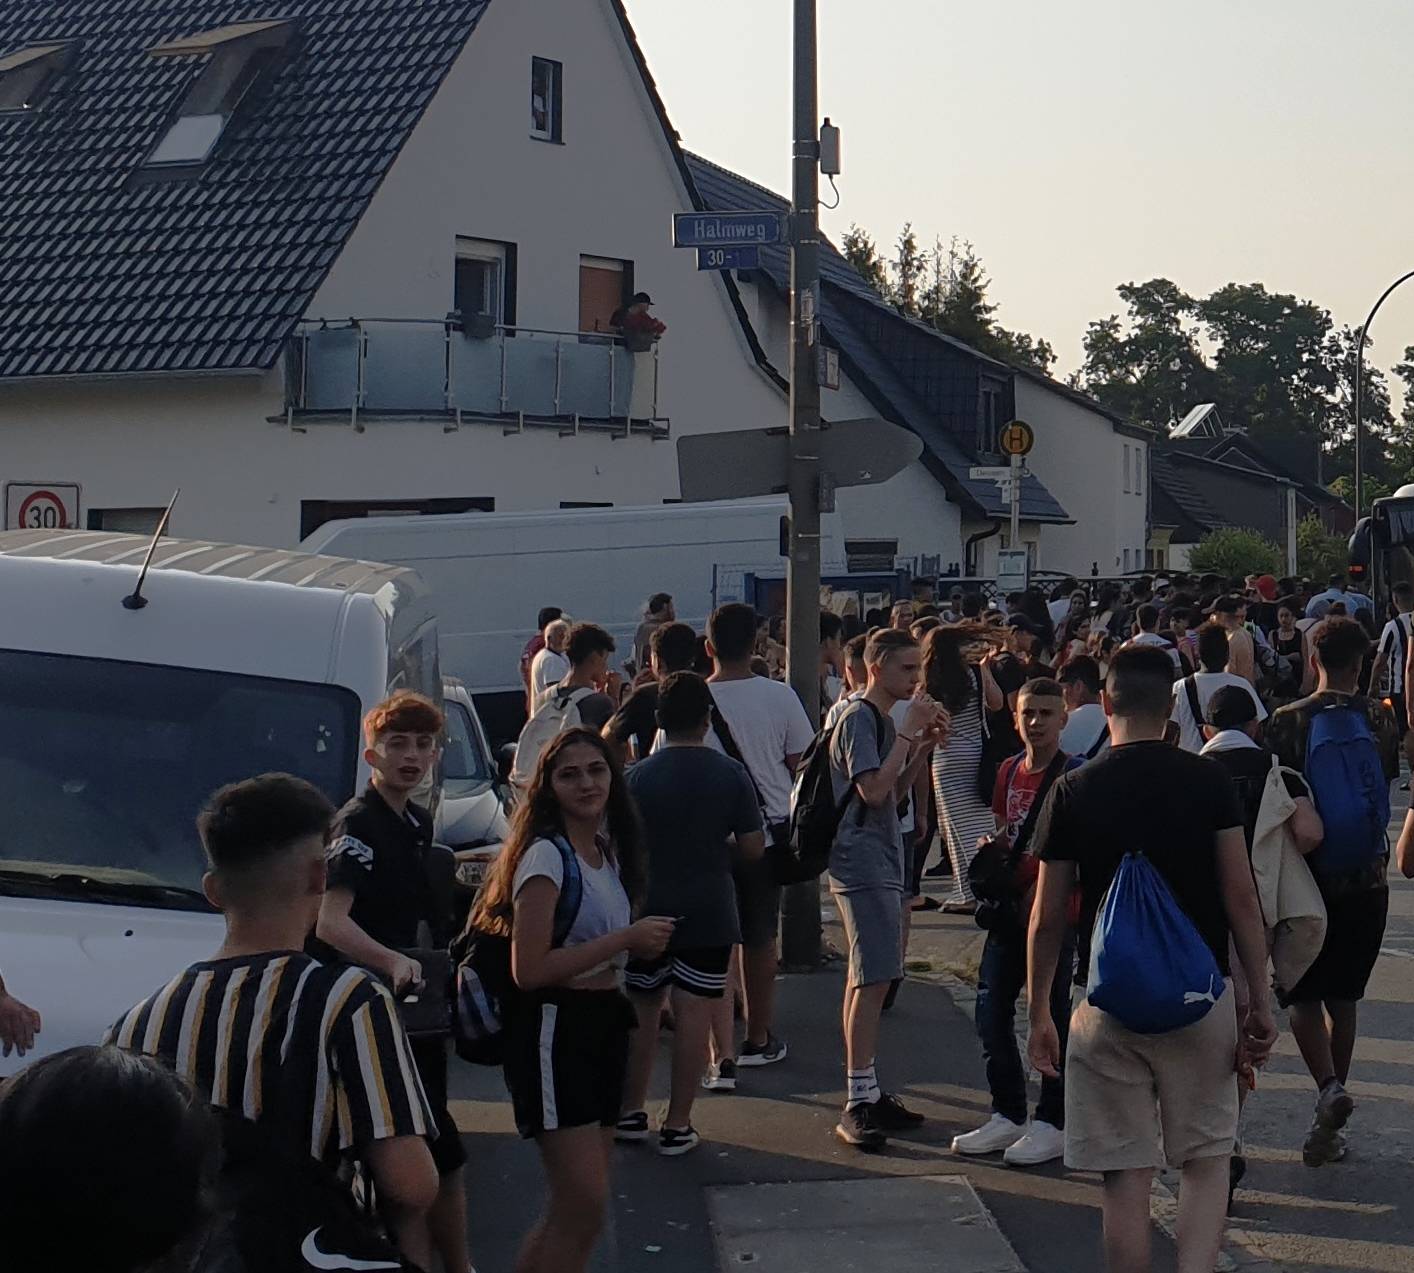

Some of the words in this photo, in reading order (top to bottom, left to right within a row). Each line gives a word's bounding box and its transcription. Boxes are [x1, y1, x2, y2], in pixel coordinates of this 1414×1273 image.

[694, 219, 766, 241] Halmweg
[1009, 427, 1024, 450] H
[29, 506, 57, 529] 30
